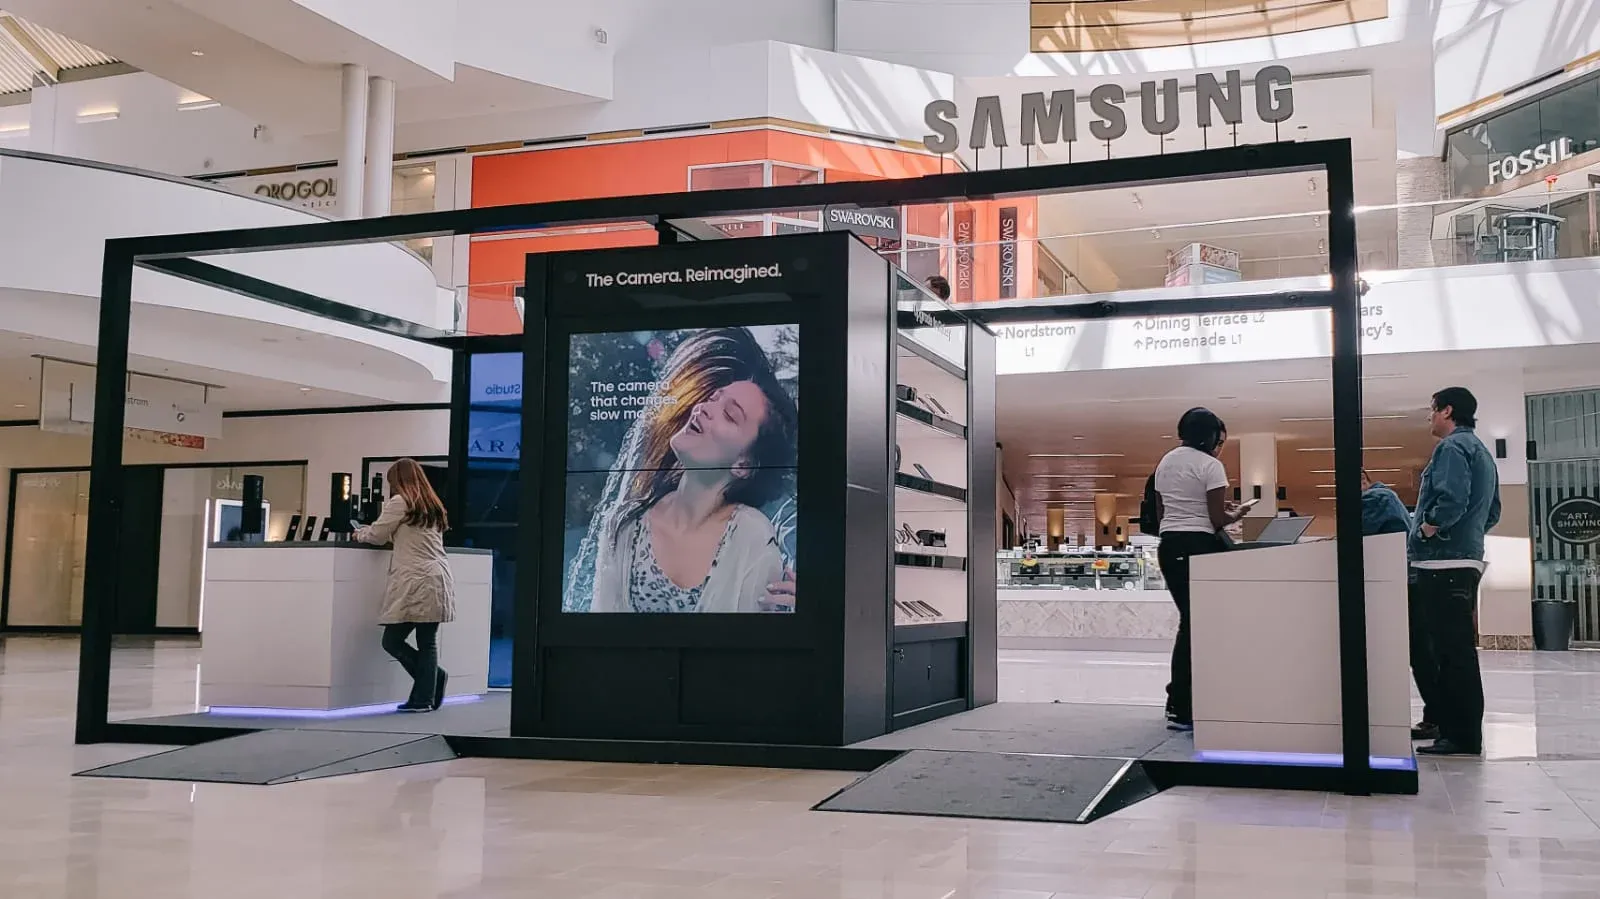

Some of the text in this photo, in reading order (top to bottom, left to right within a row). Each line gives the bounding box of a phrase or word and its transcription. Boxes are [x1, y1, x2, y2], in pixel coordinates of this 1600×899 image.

[923, 65, 1294, 153] SAMSUNG
[1488, 137, 1573, 185] FOSSIL
[254, 178, 337, 201] OROGOL
[830, 209, 894, 229] SWAROVSKI
[1002, 218, 1014, 287] SWAROVSKI
[585, 263, 782, 288] The Camera. Reimagined.
[1360, 305, 1383, 317] ars
[1145, 317, 1191, 331] Dining
[1253, 312, 1265, 323] L2
[1005, 324, 1076, 339] Nordstrom
[1361, 322, 1393, 340] cy's
[1145, 332, 1242, 350] Promenade L1
[1025, 346, 1035, 357] L1
[590, 381, 670, 393] The camera
[590, 394, 678, 407] that changes
[590, 409, 620, 421] slow
[1567, 512, 1589, 520] ART
